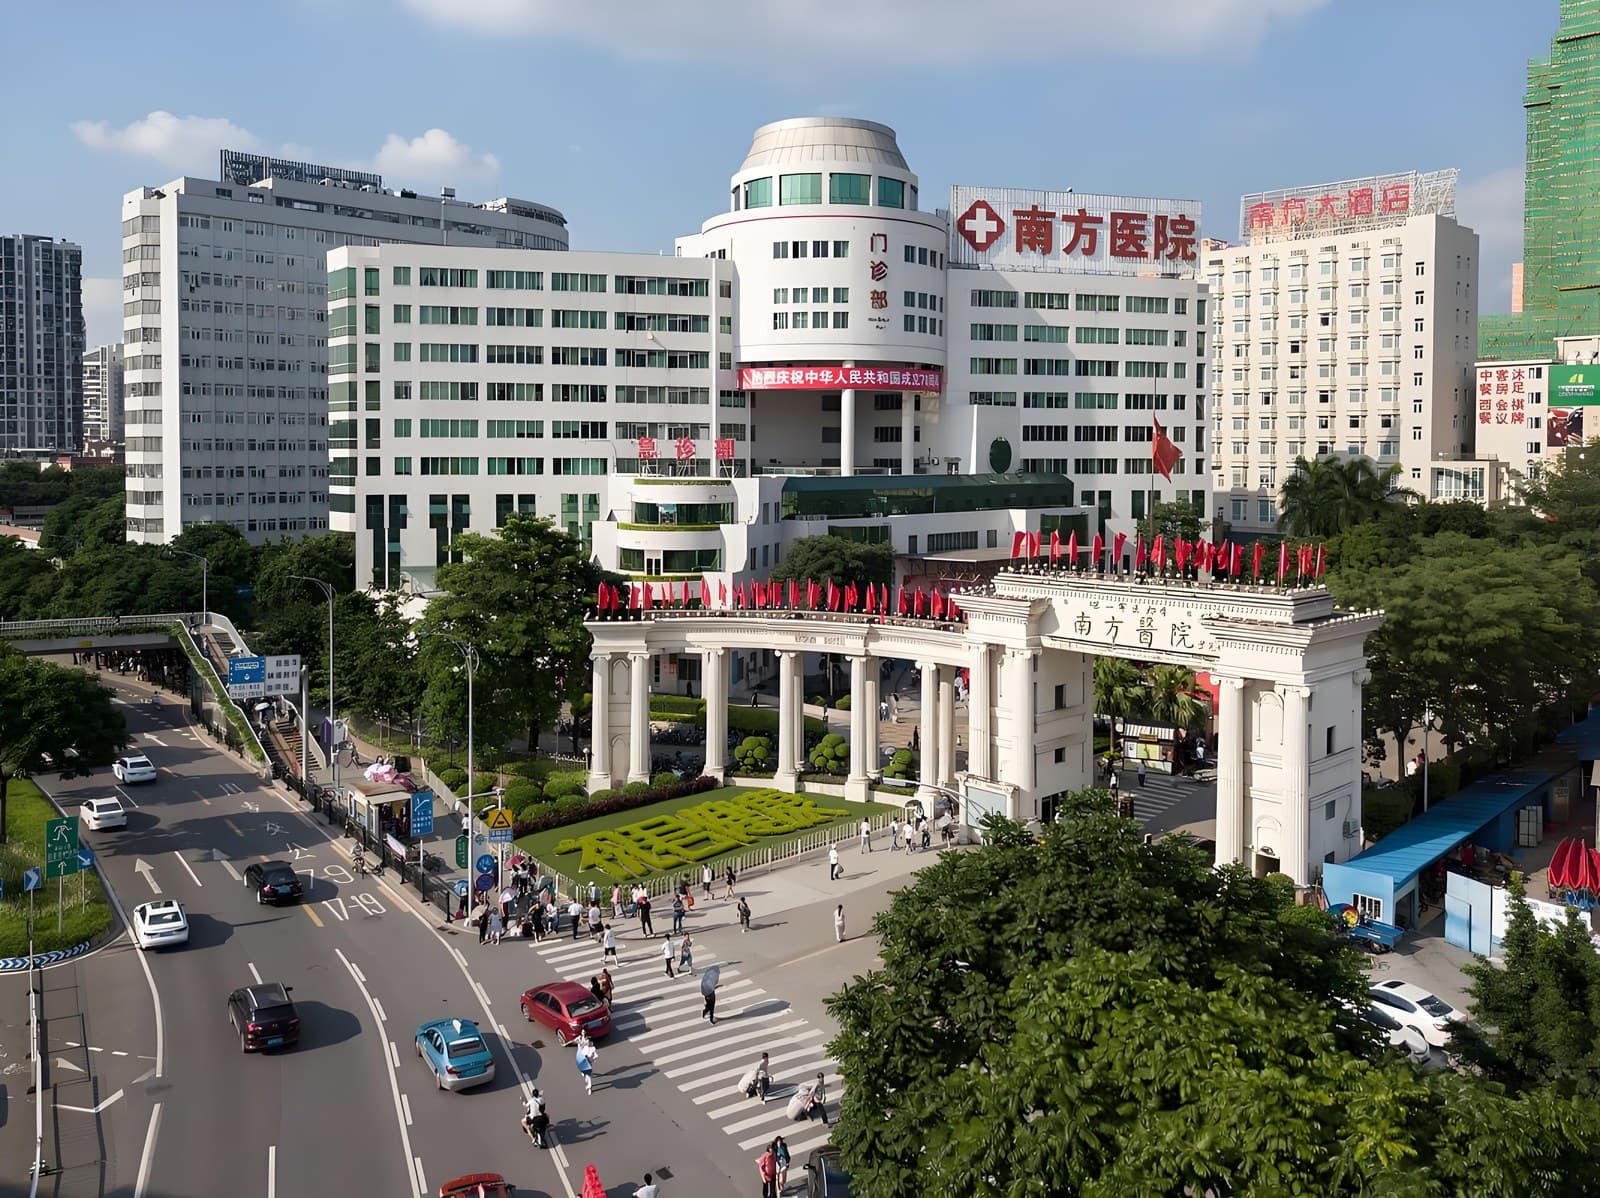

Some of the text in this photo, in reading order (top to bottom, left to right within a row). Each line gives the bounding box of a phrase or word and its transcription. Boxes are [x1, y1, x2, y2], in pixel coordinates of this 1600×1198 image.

[1012, 205, 1197, 260] 南方医院
[870, 233, 889, 309] 门诊部
[1074, 611, 1194, 648] 南方醫院
[322, 893, 387, 921] 17-19
